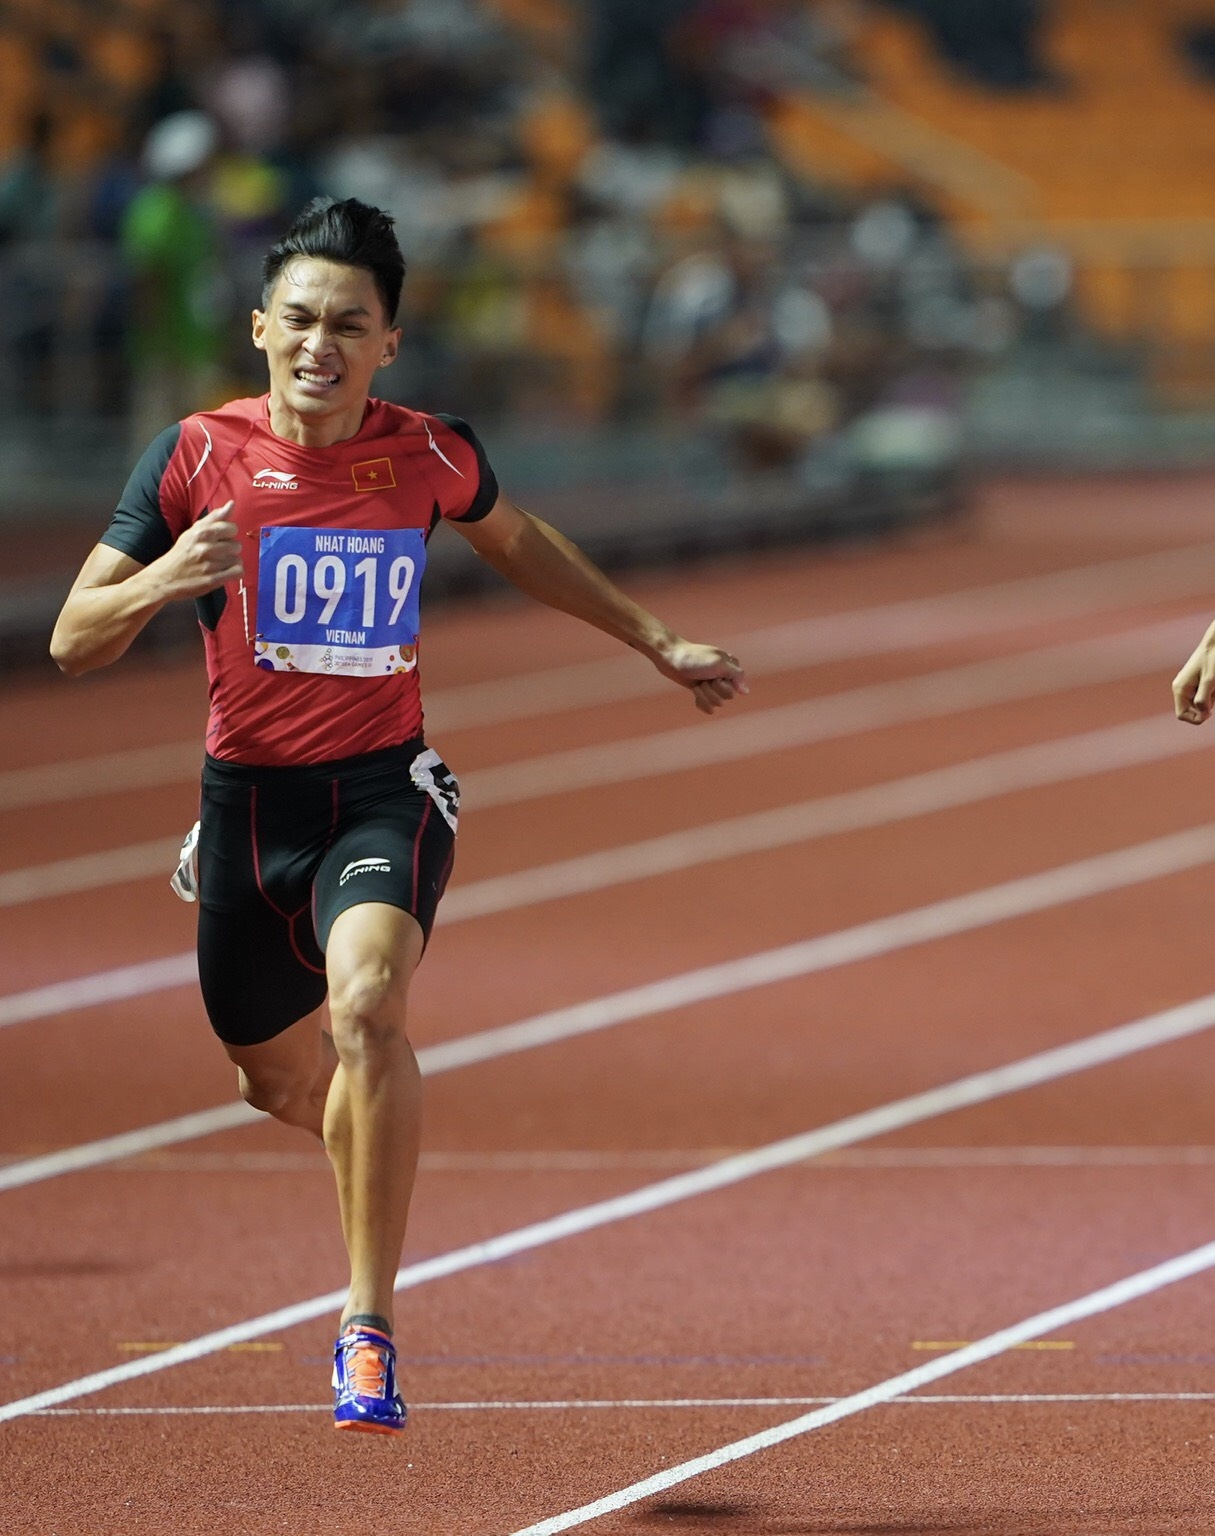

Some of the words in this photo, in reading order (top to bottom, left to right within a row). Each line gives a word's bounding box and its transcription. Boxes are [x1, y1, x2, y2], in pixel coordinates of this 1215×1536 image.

[253, 479, 298, 490] LI-NING
[315, 535, 344, 553] NHAT
[347, 536, 385, 554] HOANG
[274, 554, 415, 628] 0919
[326, 629, 366, 645] VIETNAM
